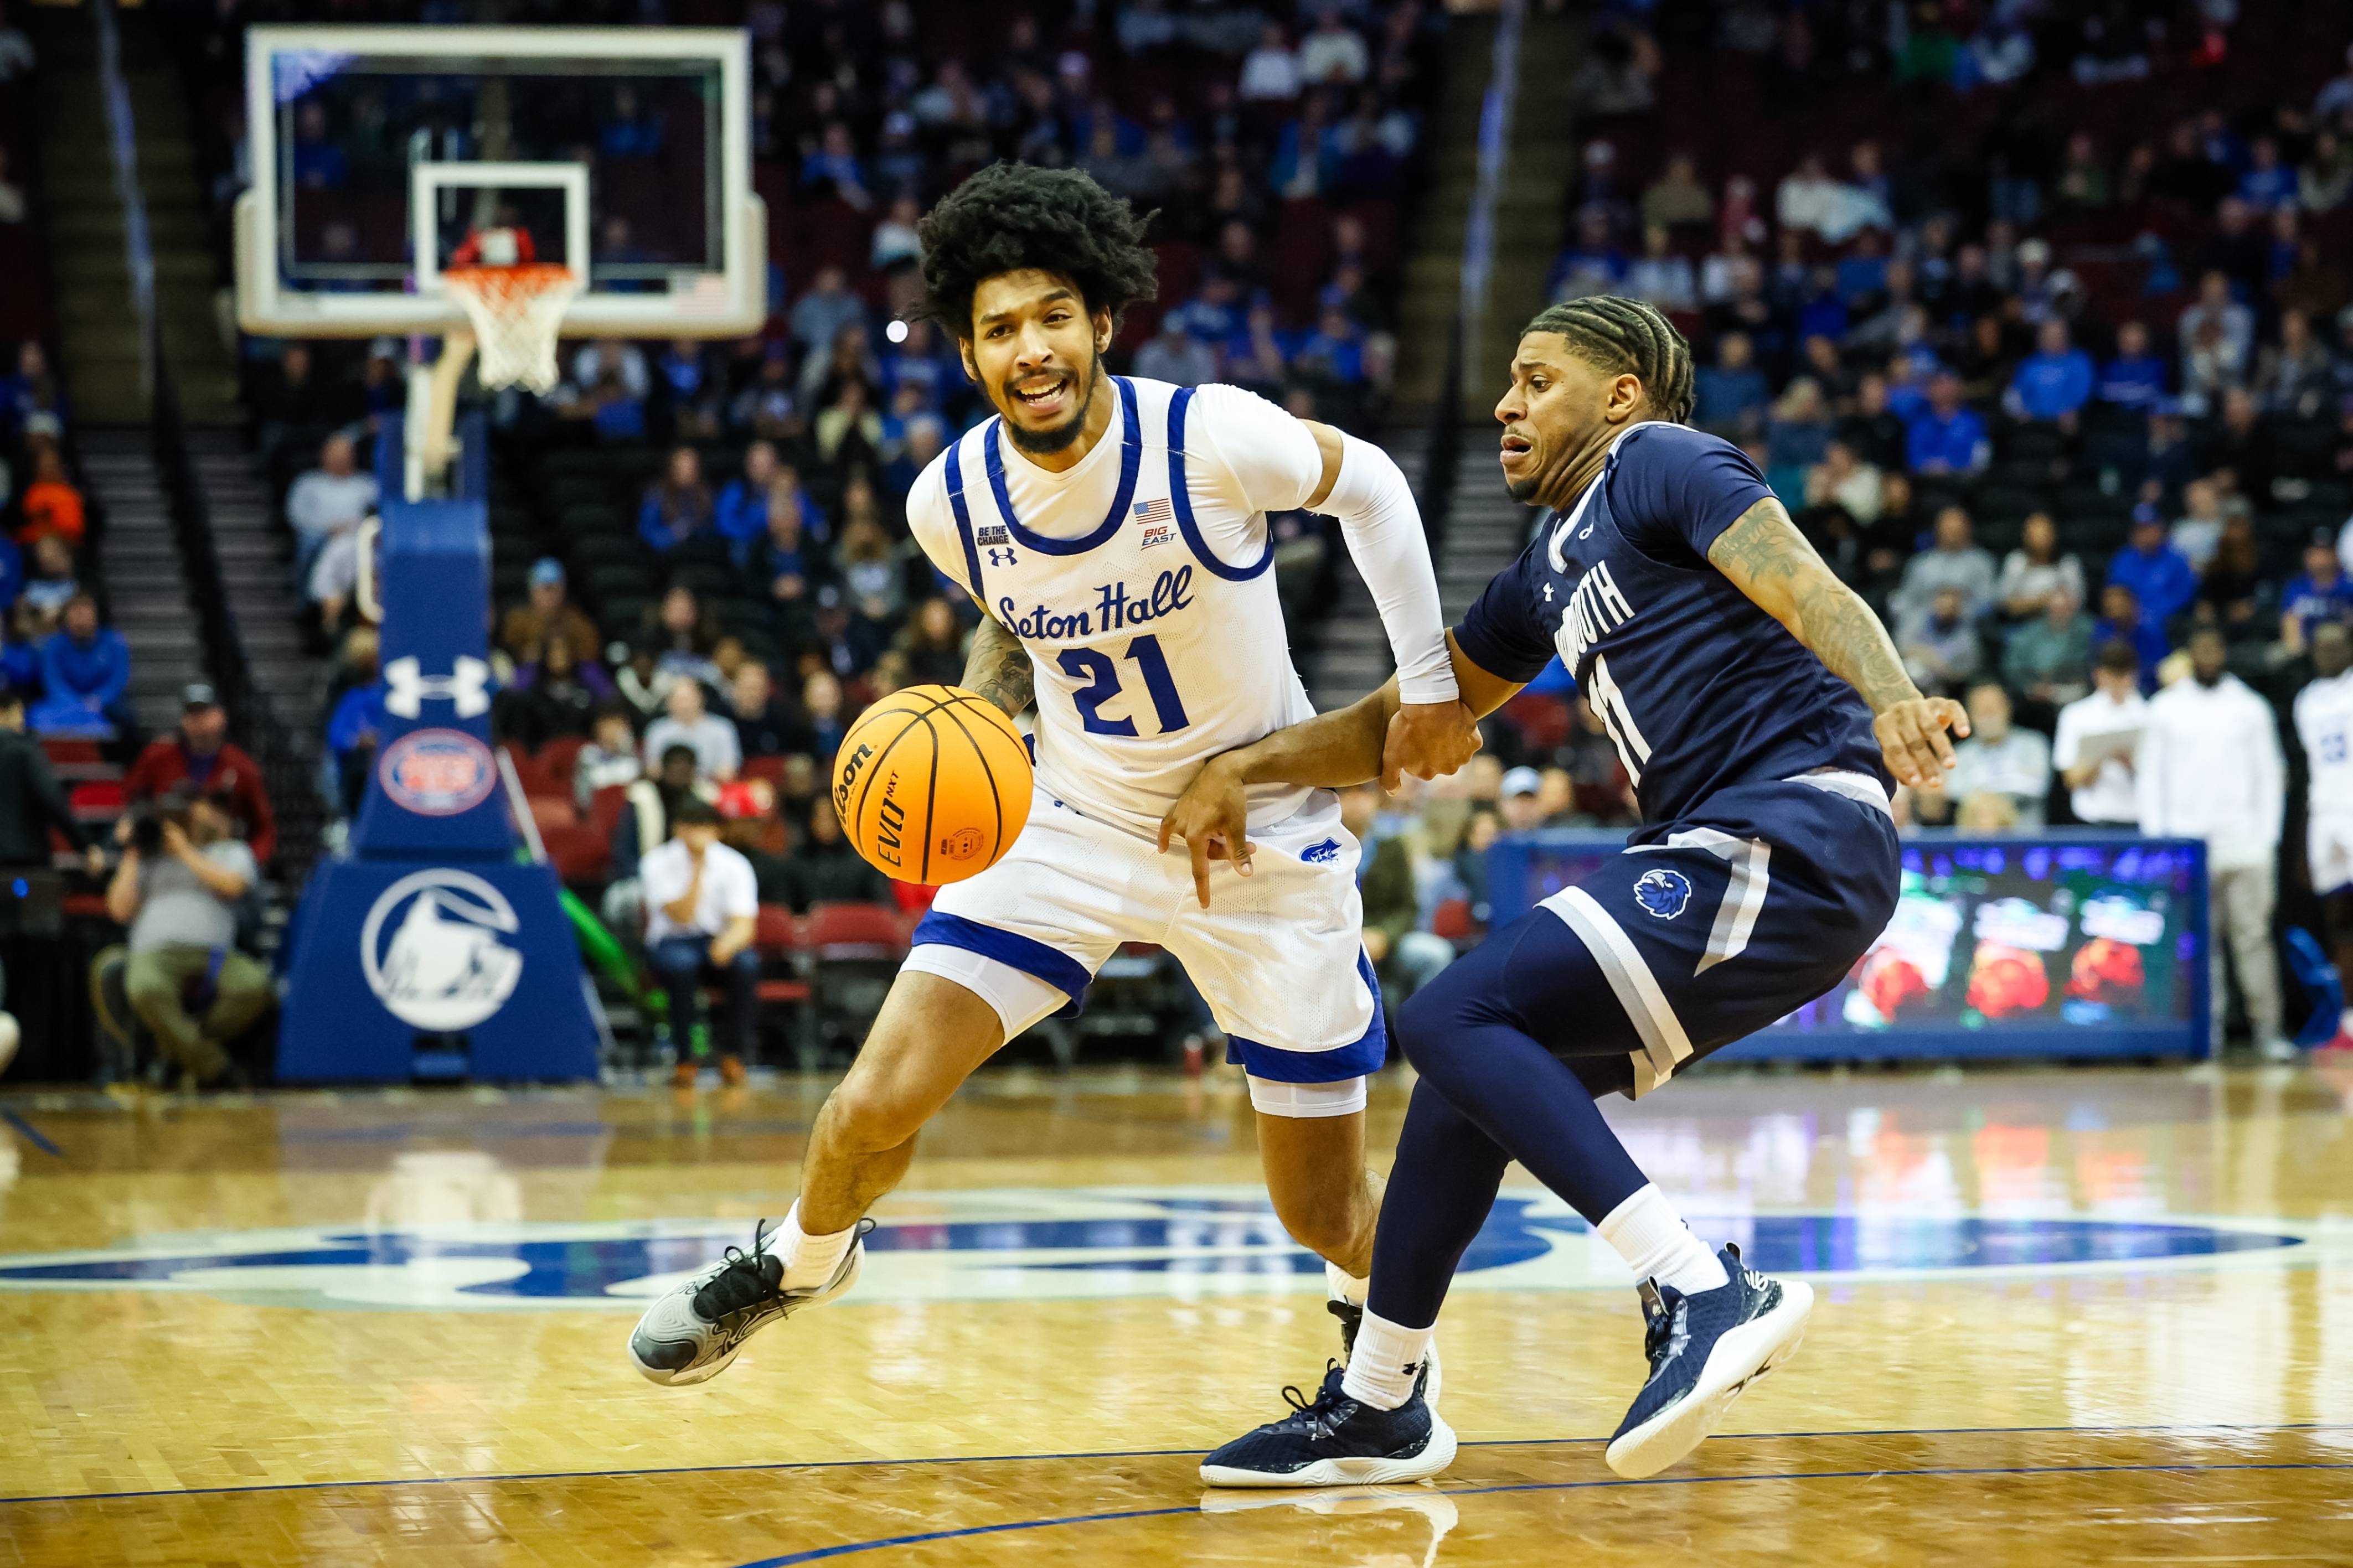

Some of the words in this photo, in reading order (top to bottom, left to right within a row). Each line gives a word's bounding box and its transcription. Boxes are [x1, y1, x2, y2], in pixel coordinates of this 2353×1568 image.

[977, 535, 1009, 546] CHANGE
[979, 527, 989, 536] BE
[992, 525, 1006, 535] THE
[1142, 533, 1177, 546] EAST
[1144, 526, 1168, 537] BIG
[999, 597, 1094, 639] Seton
[1093, 565, 1195, 632] Hall
[1056, 634, 1190, 737] 21
[886, 770, 899, 798] NXT
[878, 797, 905, 867] EVO
